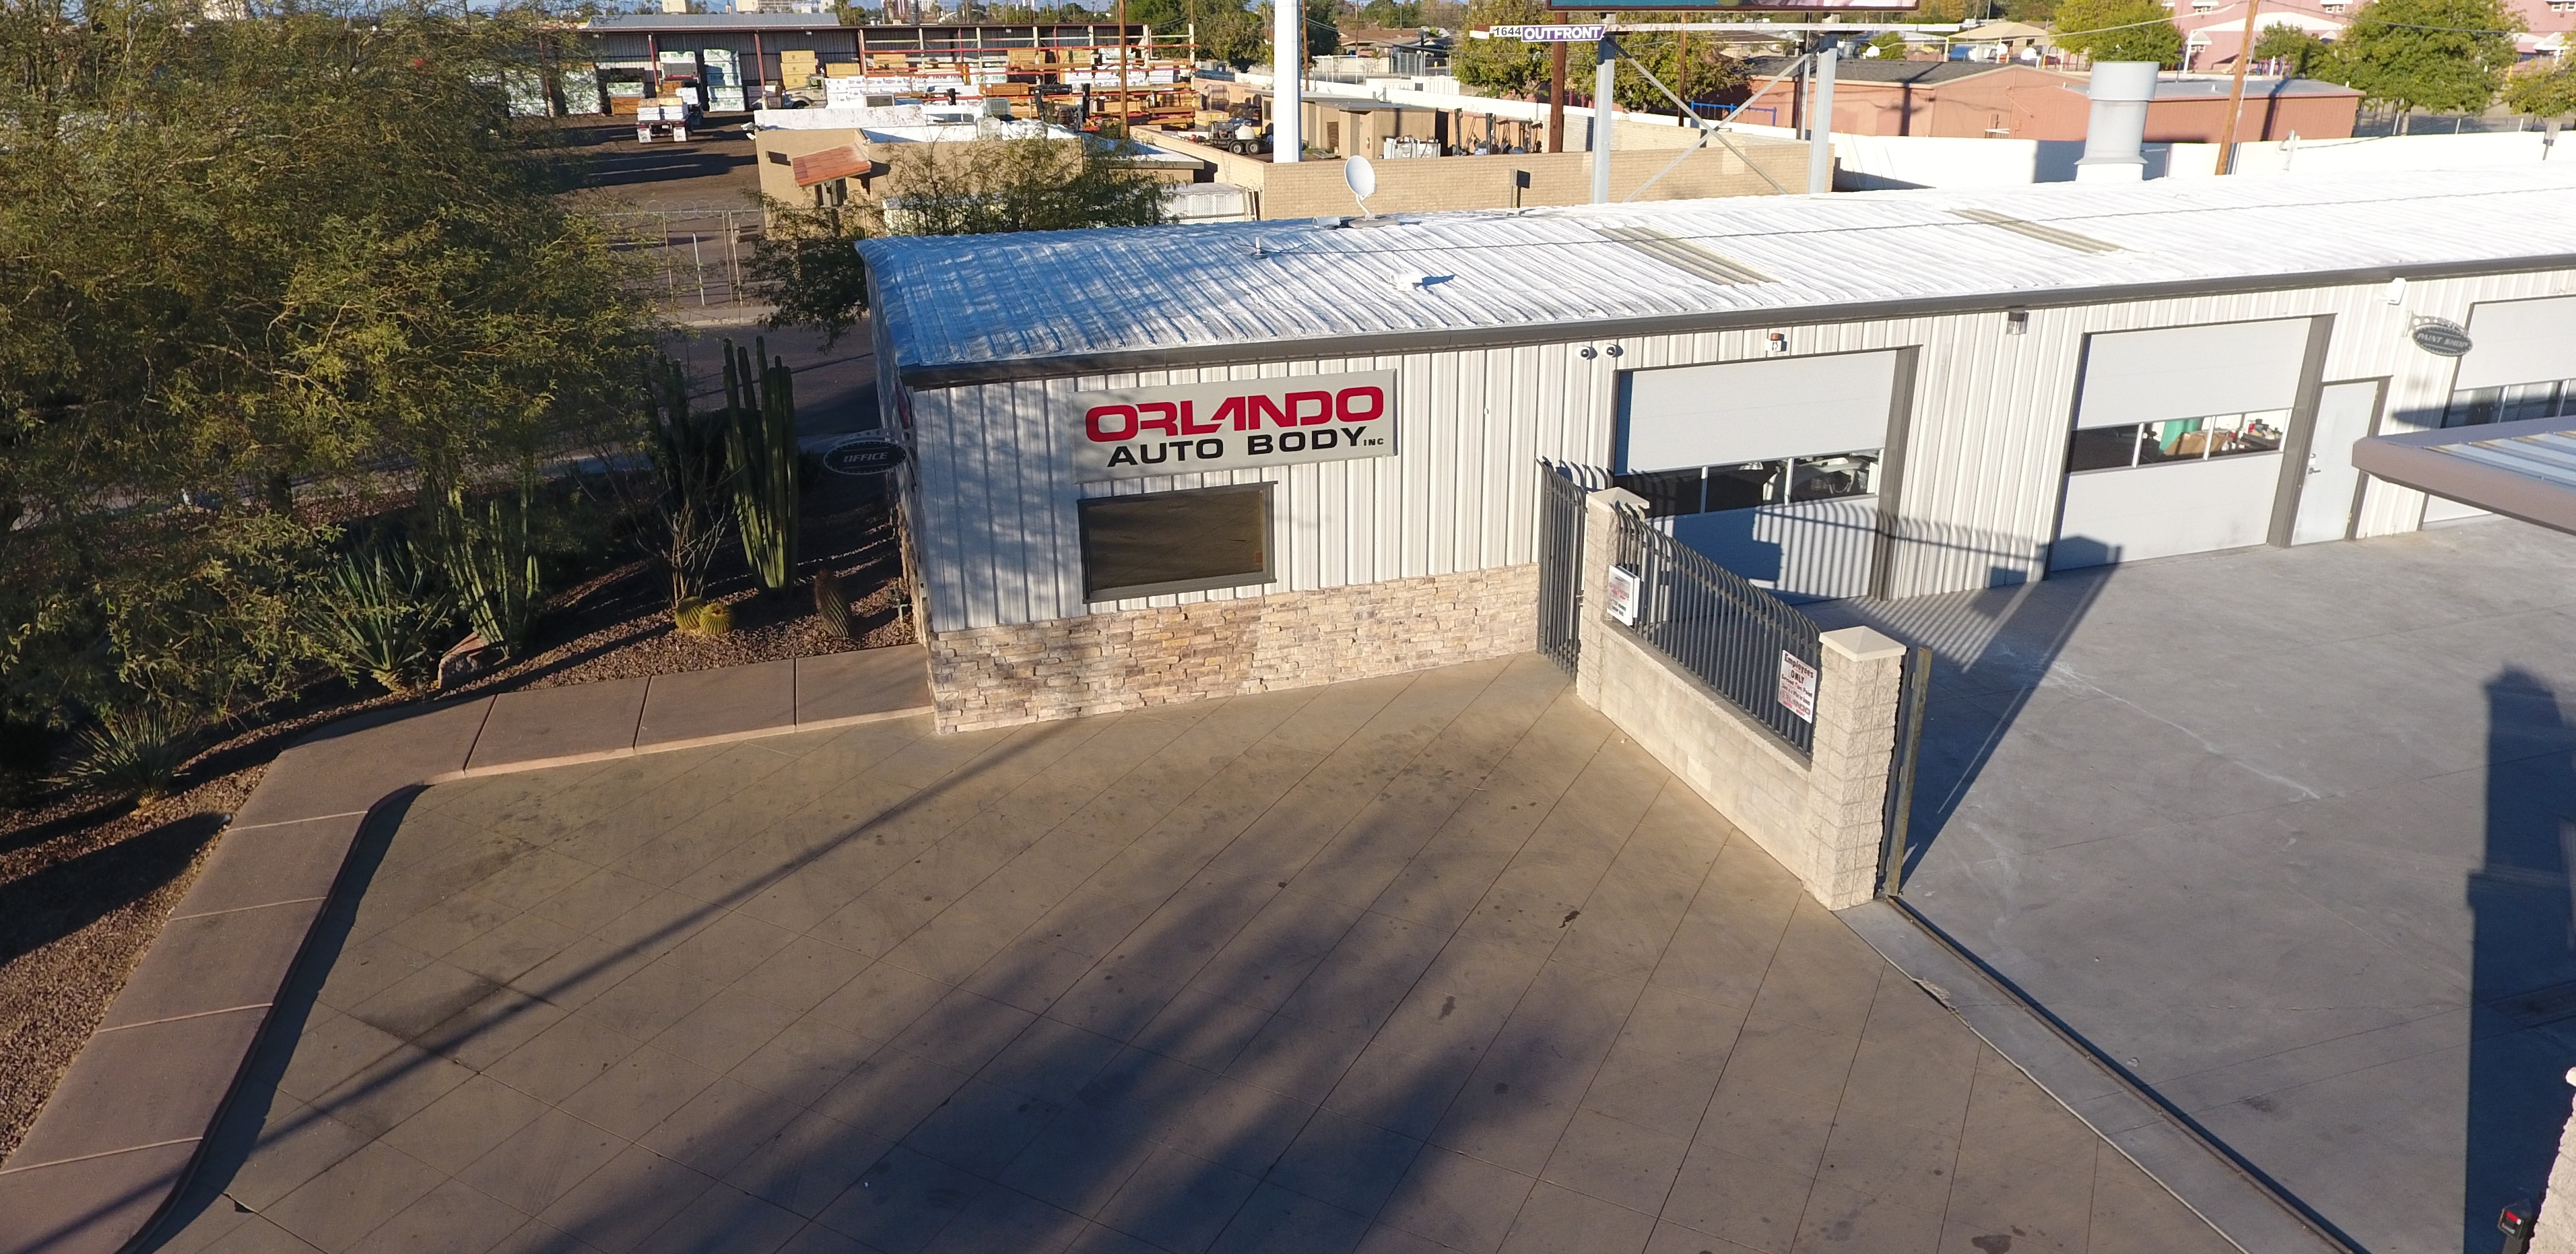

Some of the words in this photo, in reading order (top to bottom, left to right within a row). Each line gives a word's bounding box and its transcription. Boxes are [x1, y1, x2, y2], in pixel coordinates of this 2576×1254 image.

[1494, 27, 1521, 36] 1644
[1524, 26, 1602, 40] OUTFRONT
[2417, 333, 2443, 343] PAINT
[2443, 339, 2468, 348] SHOP
[1085, 386, 1384, 442] ORLANDO
[1107, 438, 1224, 467] AUTO
[1247, 426, 1367, 455] BODY
[1363, 437, 1385, 447] INC
[843, 452, 888, 463] OFFICE
[1785, 653, 1814, 679] Employees
[1791, 669, 1805, 684] ONLY
